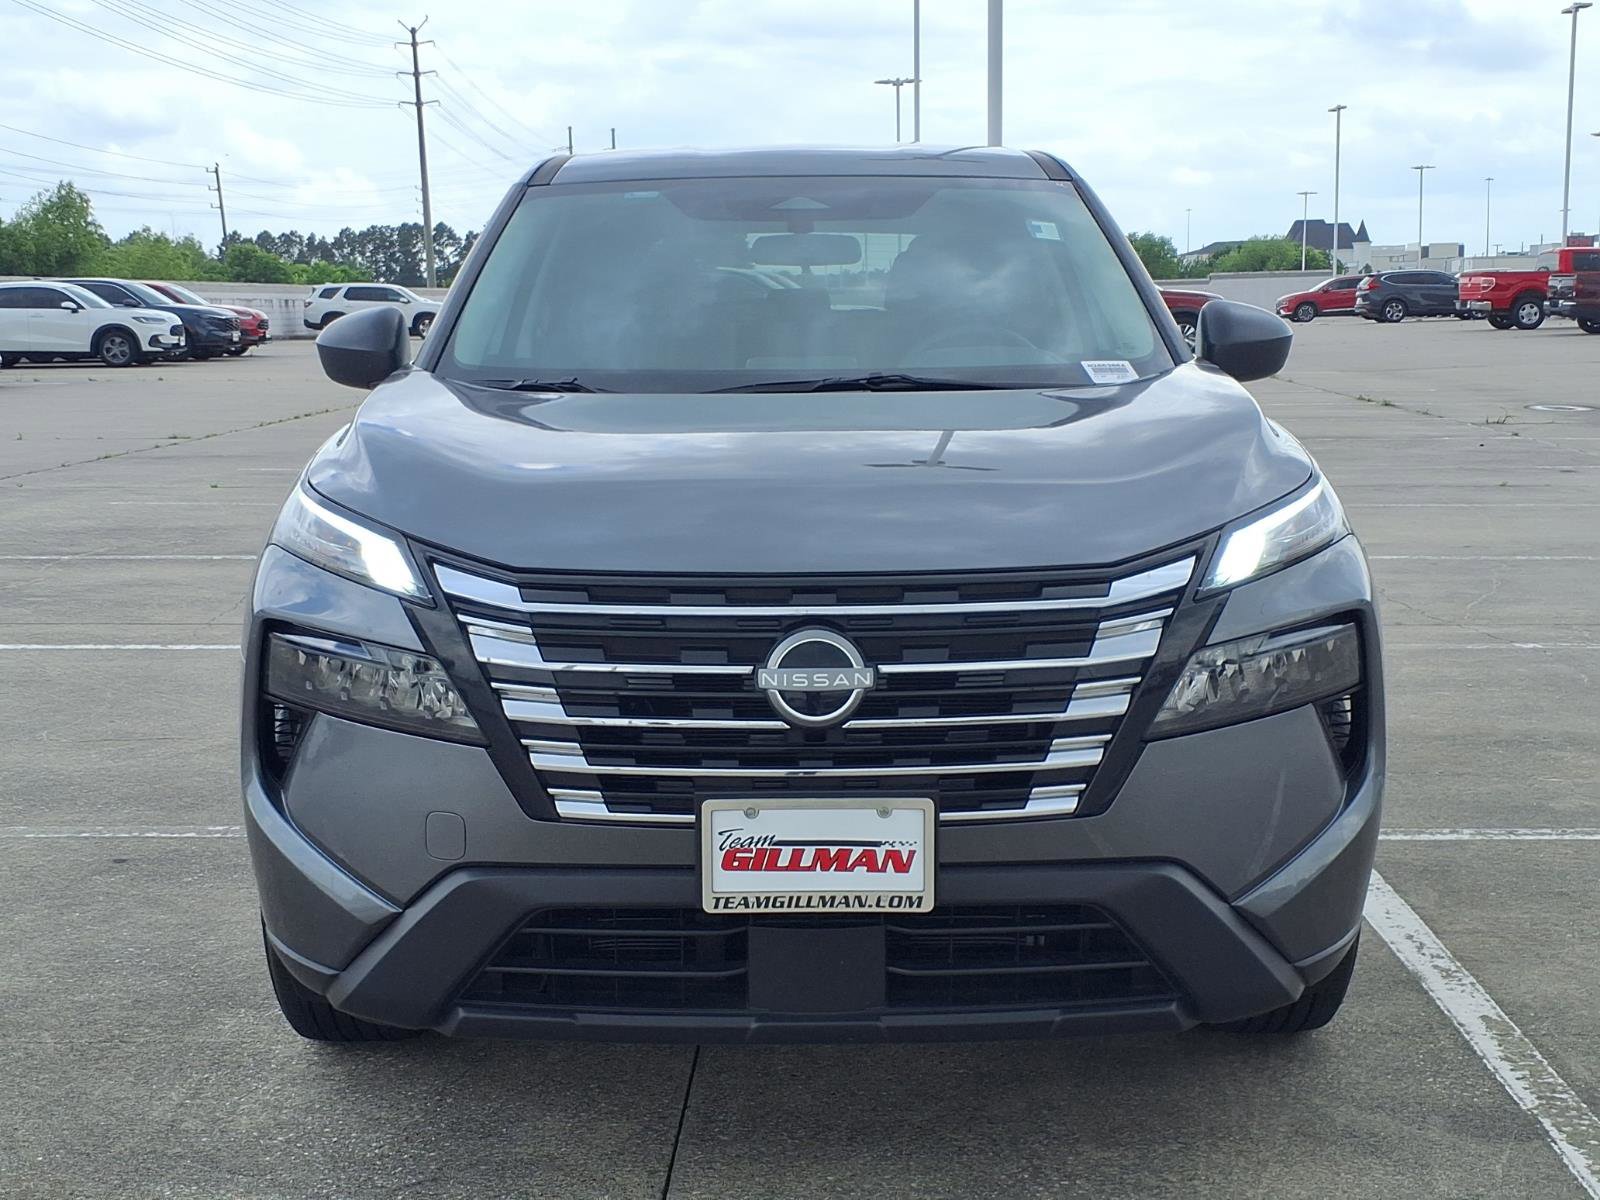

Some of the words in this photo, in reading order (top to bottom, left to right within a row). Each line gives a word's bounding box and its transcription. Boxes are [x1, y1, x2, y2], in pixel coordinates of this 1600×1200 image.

[762, 672, 870, 687] NISSAN
[718, 828, 775, 851] Team
[720, 848, 917, 873] GILLMAN
[712, 895, 923, 910] TEAMGILLMAN.COM
